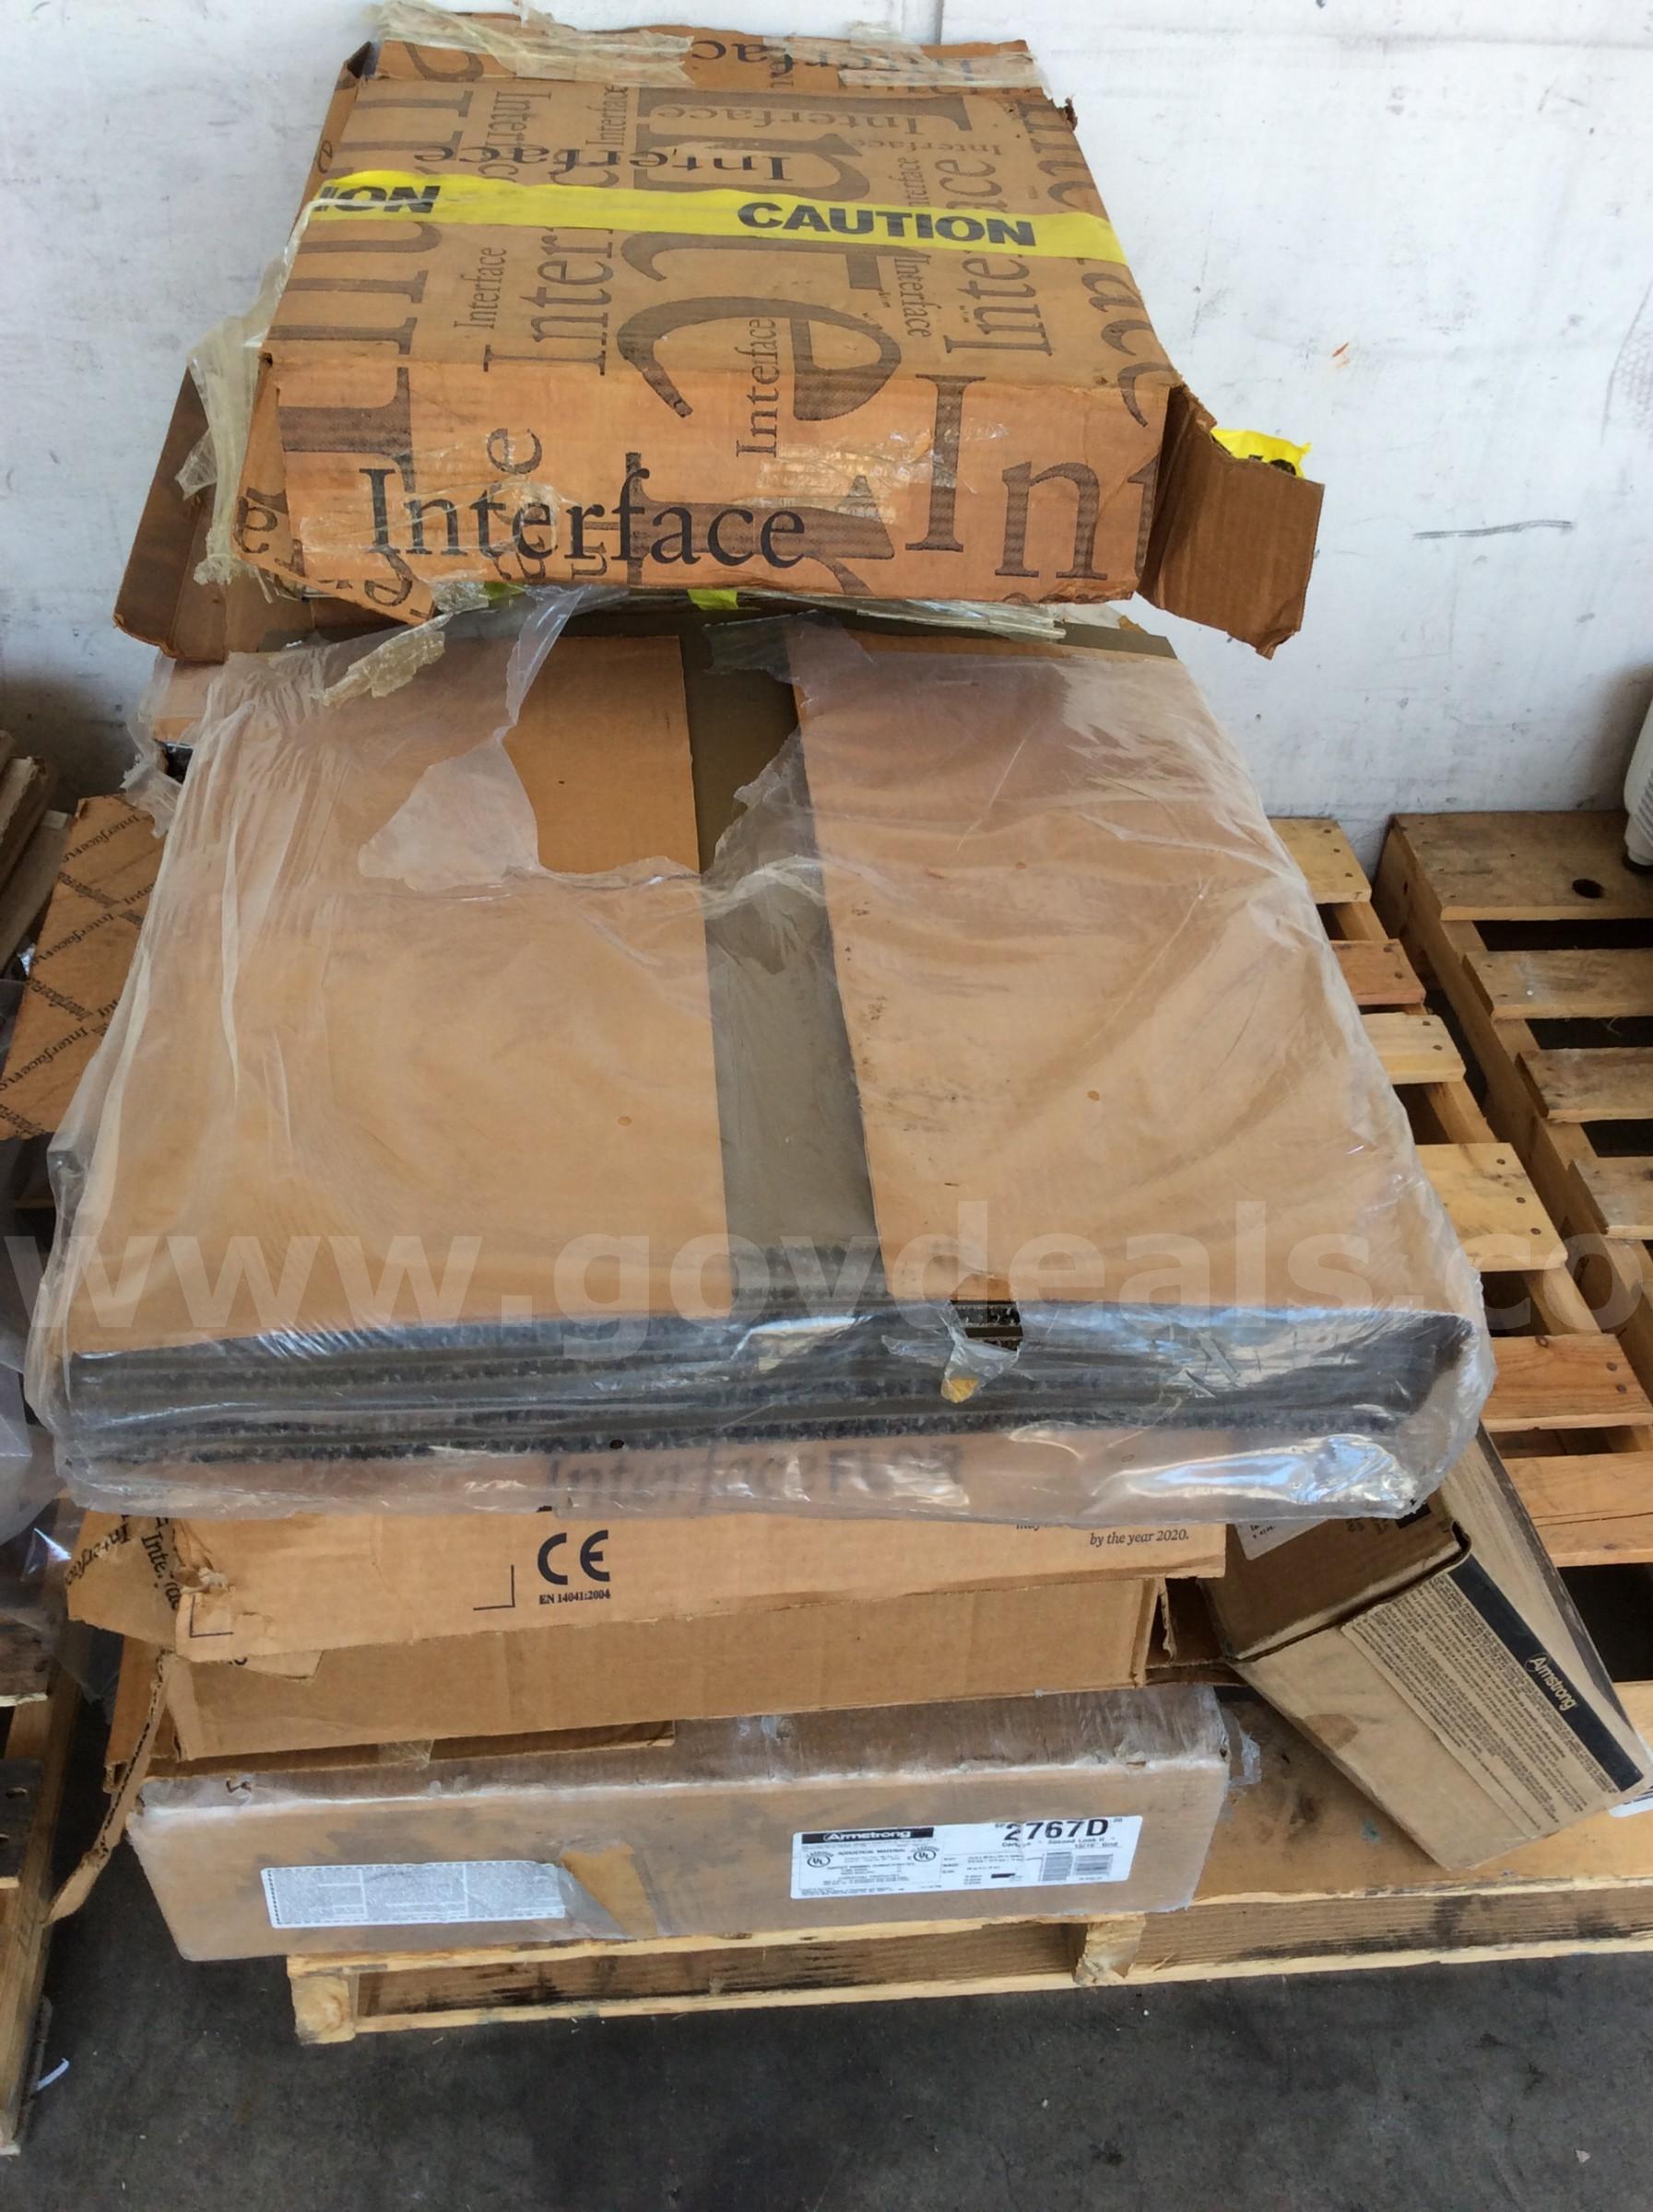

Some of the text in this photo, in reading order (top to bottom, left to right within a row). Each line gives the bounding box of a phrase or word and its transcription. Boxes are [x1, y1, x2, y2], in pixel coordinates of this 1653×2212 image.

[657, 104, 925, 135] Interface
[413, 144, 793, 182] Interface
[737, 201, 1037, 247] CAUTION
[453, 245, 507, 330] Interface
[736, 316, 779, 458] Interface
[358, 467, 805, 567] Interface
[1090, 1529, 1188, 1547] by the year 2020.
[538, 1589, 611, 1605] EN 14041:2004
[1526, 1653, 1576, 1711] Armstrong
[824, 1830, 911, 1842] Armstrong
[1003, 1818, 1109, 1841] 2767D
